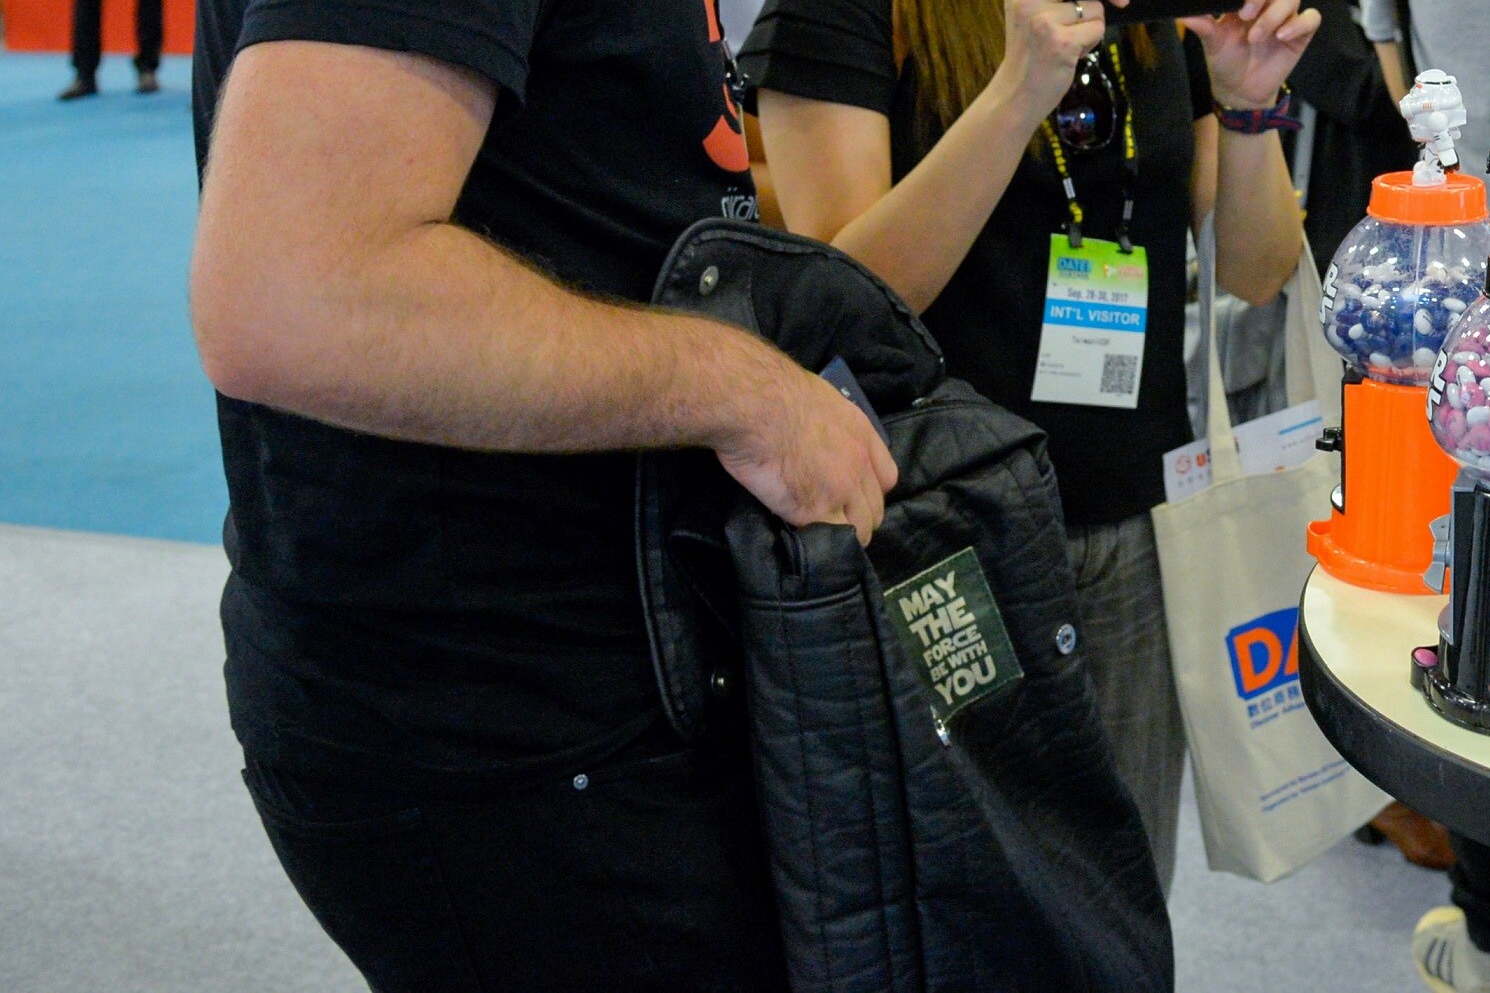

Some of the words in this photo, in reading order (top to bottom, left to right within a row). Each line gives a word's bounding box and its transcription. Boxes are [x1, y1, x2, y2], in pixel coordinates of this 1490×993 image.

[1050, 305, 1084, 321] INT'L
[1088, 309, 1141, 326] VISITOR
[899, 570, 957, 623] MAY
[909, 596, 976, 647] THE
[923, 623, 982, 667] FORCE
[930, 662, 949, 682] BE
[947, 639, 988, 670] WITH
[934, 654, 997, 705] YOU
